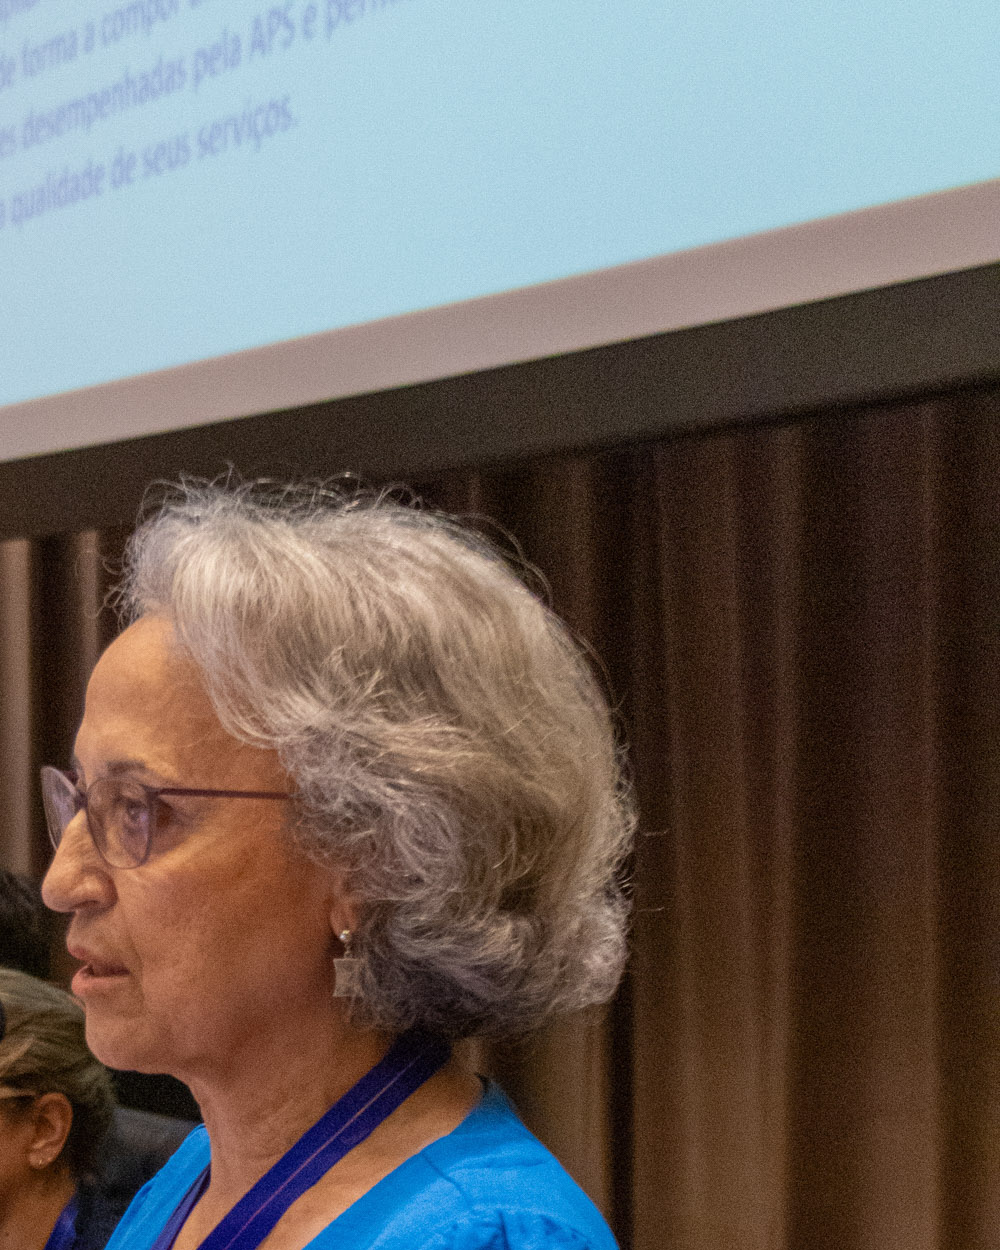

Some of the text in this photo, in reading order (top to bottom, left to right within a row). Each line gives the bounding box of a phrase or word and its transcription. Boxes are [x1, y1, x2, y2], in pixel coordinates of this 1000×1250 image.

[20, 30, 78, 77] forma
[21, 57, 187, 148] desempenhadas
[192, 27, 242, 89] pela
[249, 0, 295, 57] APS
[300, 3, 317, 40] e
[10, 159, 105, 230] qualidade
[109, 147, 137, 190] de
[141, 136, 190, 179] seus
[196, 95, 298, 157] serviços.
